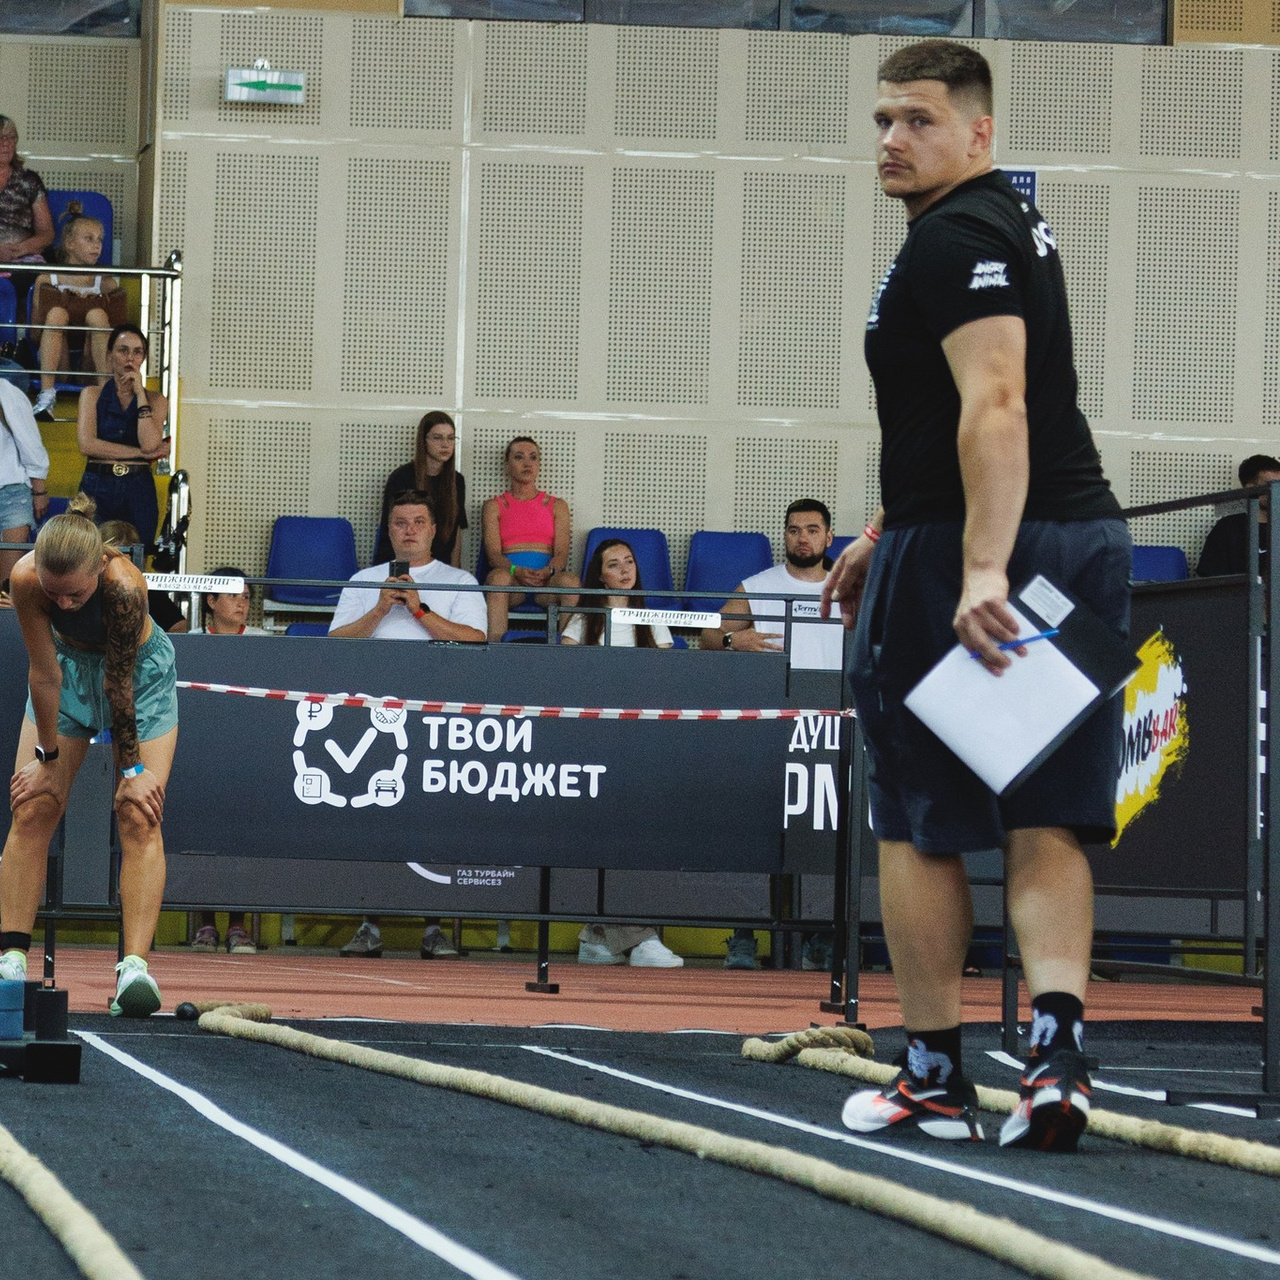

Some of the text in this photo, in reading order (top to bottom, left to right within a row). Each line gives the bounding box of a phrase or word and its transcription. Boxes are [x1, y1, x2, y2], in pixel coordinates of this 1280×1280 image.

[422, 759, 607, 803] БЮДЖЕТ
[457, 869, 516, 879] ГАЗ ТУРБАЙН
[457, 877, 503, 887] СЕРВИСЕЗ
